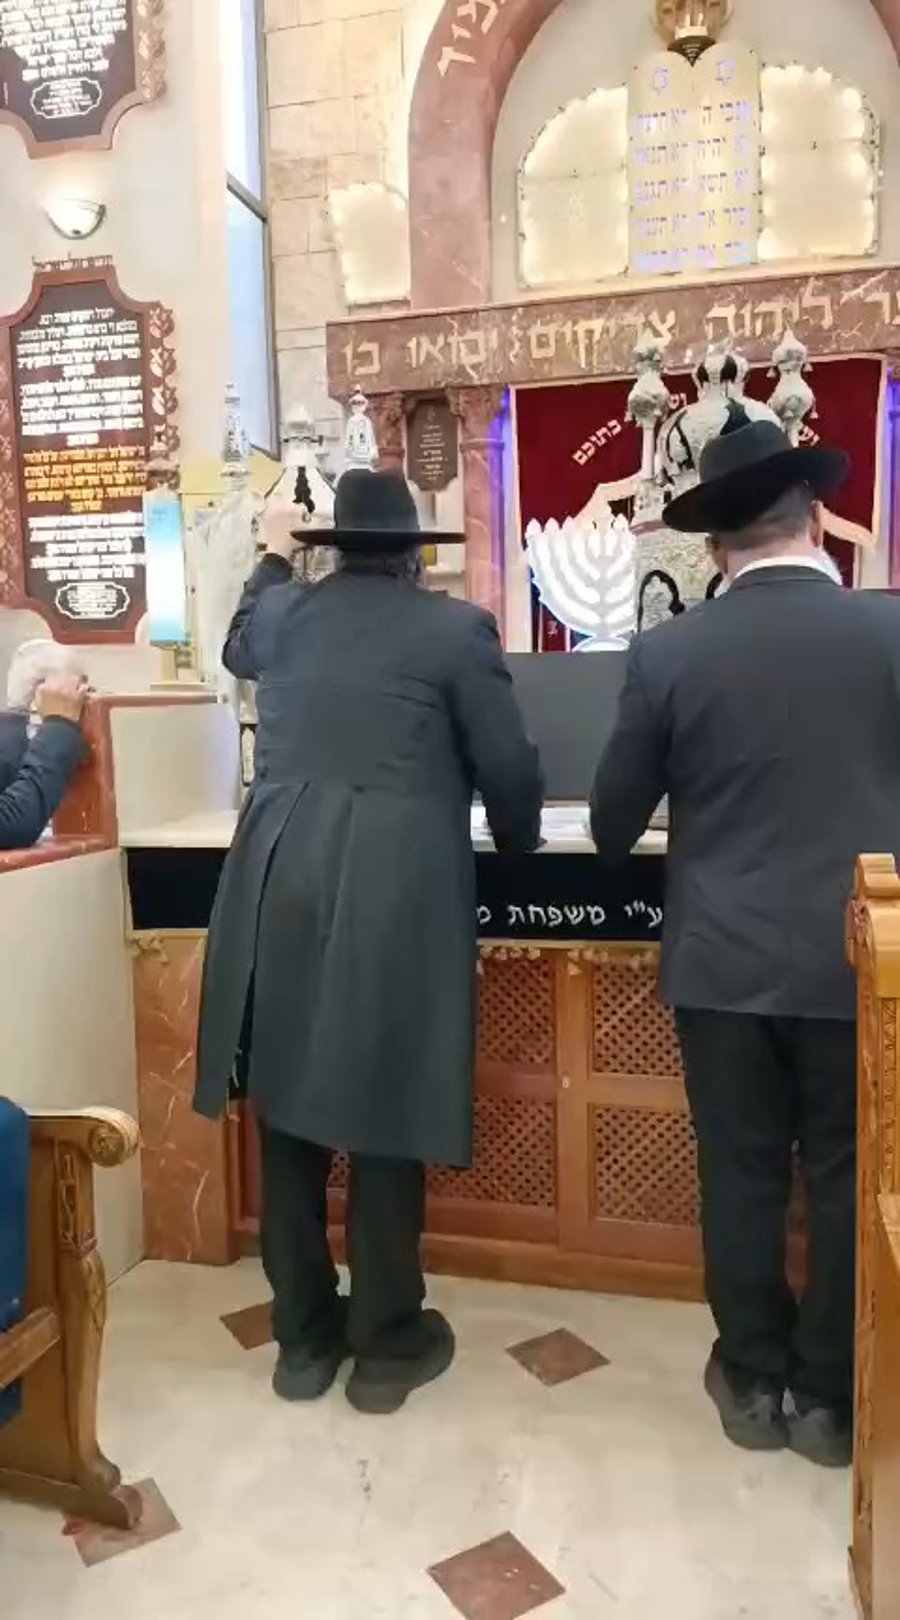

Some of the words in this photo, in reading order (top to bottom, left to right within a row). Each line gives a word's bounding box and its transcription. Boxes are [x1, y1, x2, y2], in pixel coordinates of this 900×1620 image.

[437, 0, 505, 77] מיד
[528, 308, 677, 369] צדיקים
[343, 339, 382, 378] בו
[475, 904, 493, 926] מ
[507, 902, 607, 928] משפחת
